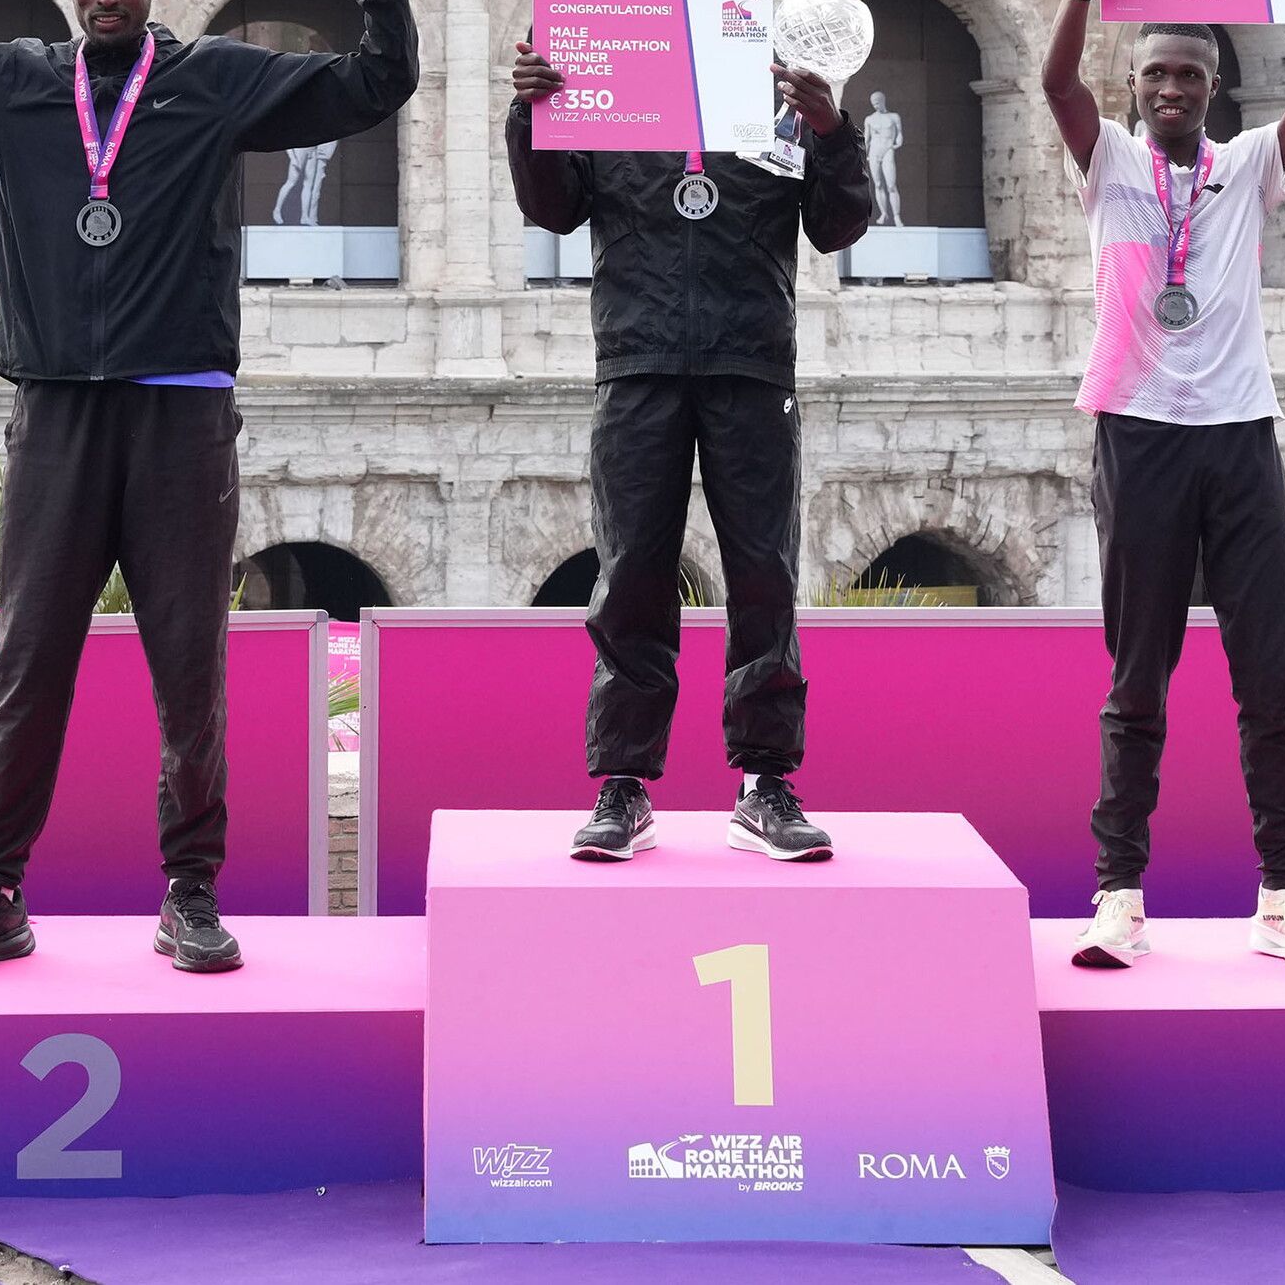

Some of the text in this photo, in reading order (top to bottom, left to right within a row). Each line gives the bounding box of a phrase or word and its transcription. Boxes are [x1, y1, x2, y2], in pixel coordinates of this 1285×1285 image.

[550, 4, 672, 15] CONGRATULATIONS!
[550, 27, 588, 37] MALE
[550, 39, 670, 52] HALF MARATHON
[550, 52, 608, 63] RUNNER
[568, 64, 613, 75] PLACE
[550, 112, 661, 123] WIZZ AIR VOUCHER
[692, 944, 774, 1106] 1
[16, 1033, 123, 1180] 2
[710, 1134, 802, 1150] WIZZ AIR
[685, 1149, 802, 1164] ROME HALF
[685, 1164, 803, 1178] MARATHON
[858, 1153, 967, 1180] ROMA
[490, 1178, 552, 1187] wizzair.com
[738, 1181, 803, 1192] by BROOKS
